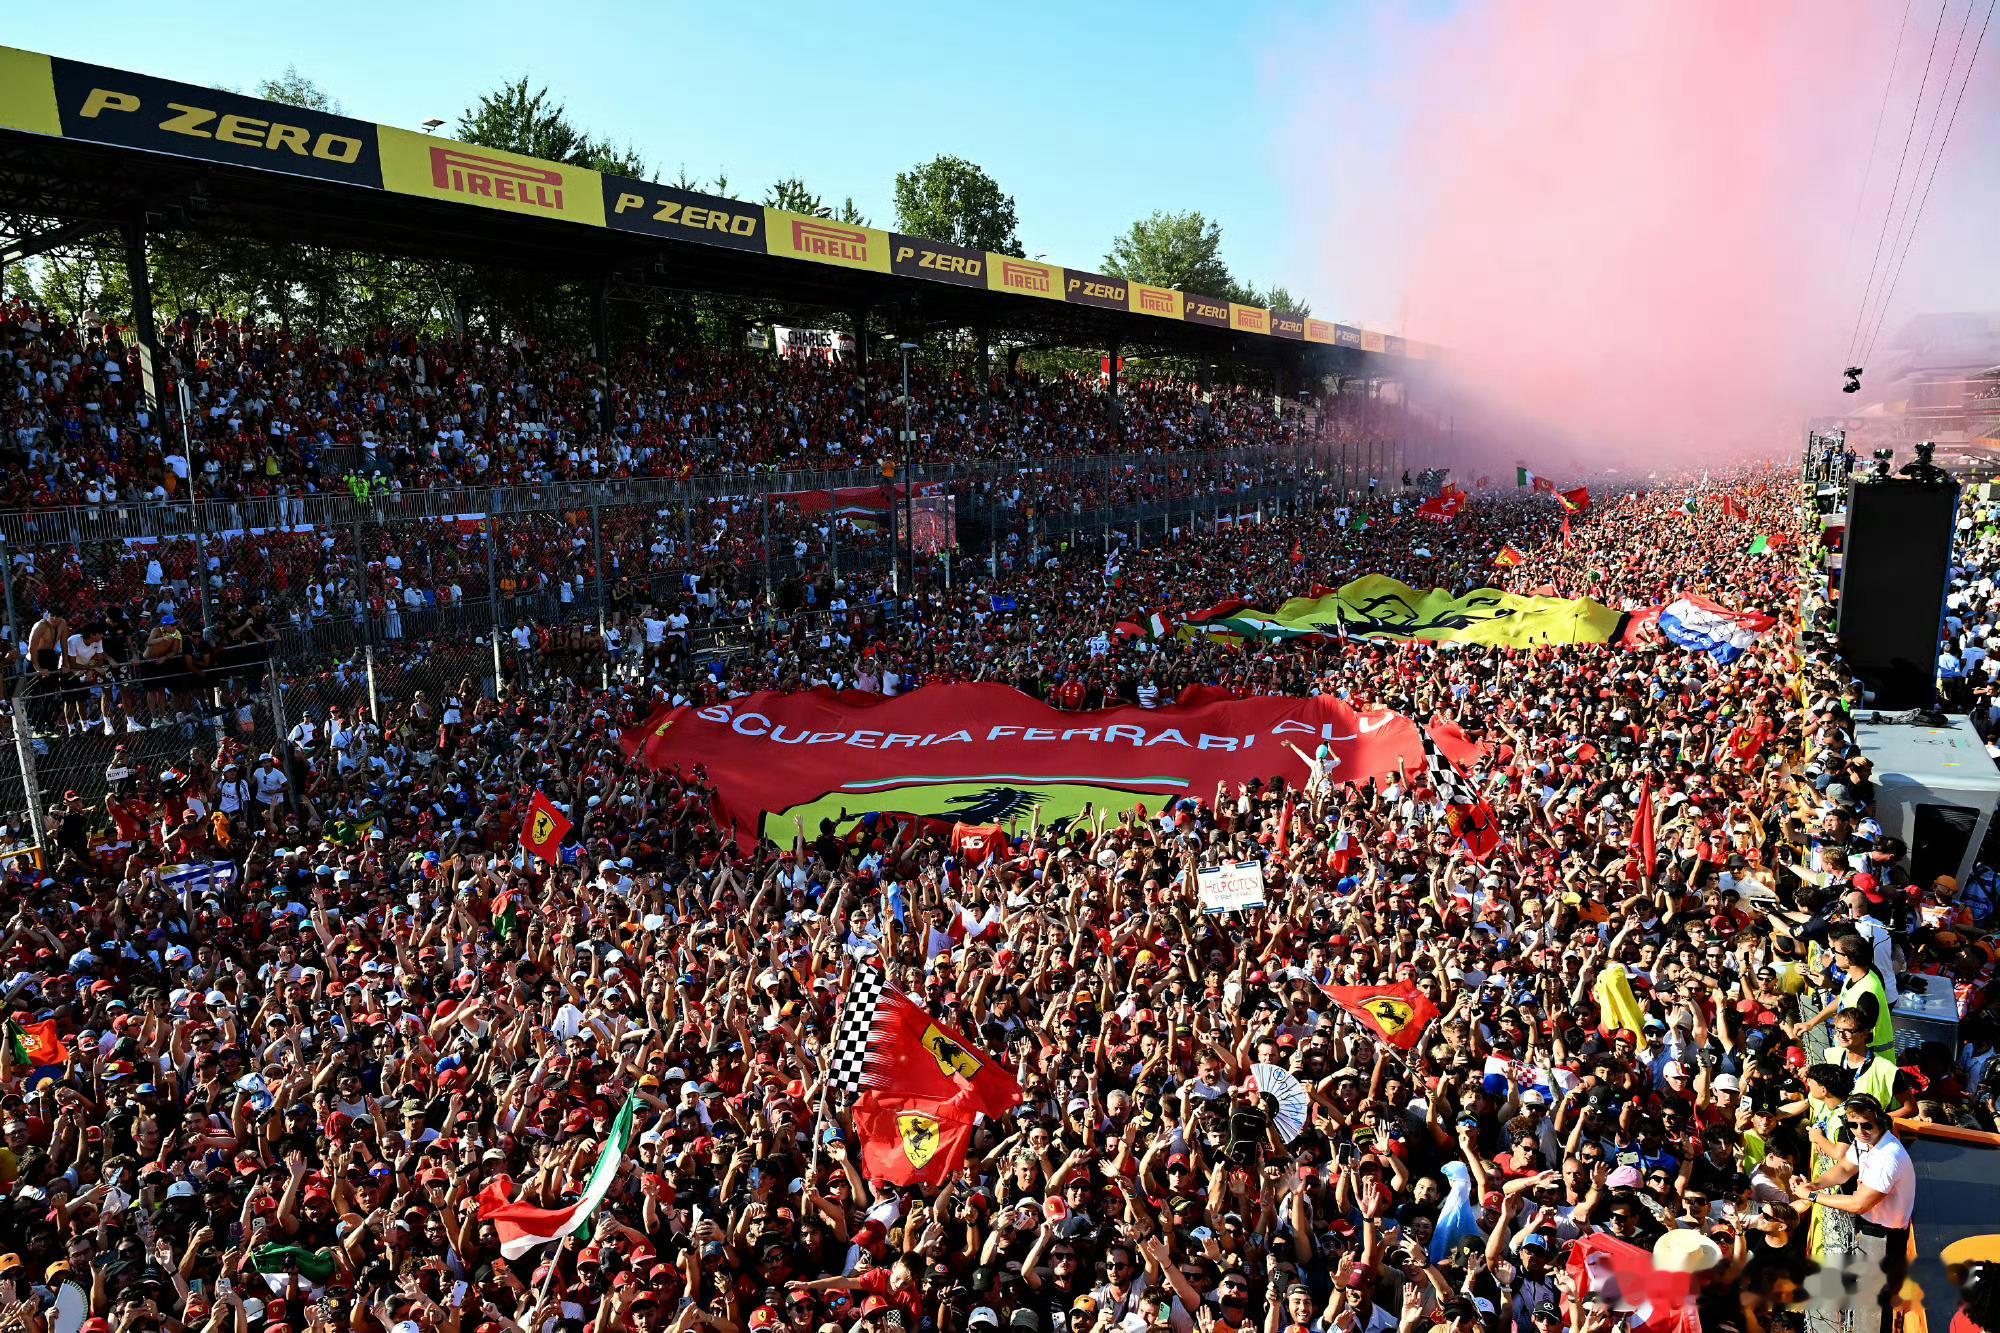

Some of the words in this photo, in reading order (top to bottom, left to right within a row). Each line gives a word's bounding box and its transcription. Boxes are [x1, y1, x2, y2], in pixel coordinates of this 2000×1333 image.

[80, 88, 141, 118] P
[158, 103, 363, 164] ZERO
[429, 146, 563, 210] PIRELLI
[614, 192, 645, 213] P
[652, 200, 757, 237] ZERO
[792, 220, 867, 262] PIRELLI
[896, 247, 914, 264] P
[918, 250, 982, 277] ZERO
[1003, 261, 1050, 293] PIRELLI
[1068, 279, 1081, 293] P
[1082, 281, 1126, 301] ZERO
[1140, 288, 1174, 313] PIRELLI
[1185, 303, 1195, 314] P
[1196, 303, 1228, 320] ZERO
[1237, 308, 1263, 329] PIRELLI
[788, 331, 832, 346] CHARLES
[1271, 319, 1280, 330] P
[1281, 320, 1303, 334] ZERO
[1343, 331, 1360, 344] ZERO
[696, 704, 973, 750] SCUDERIA
[961, 836, 984, 849] 16
